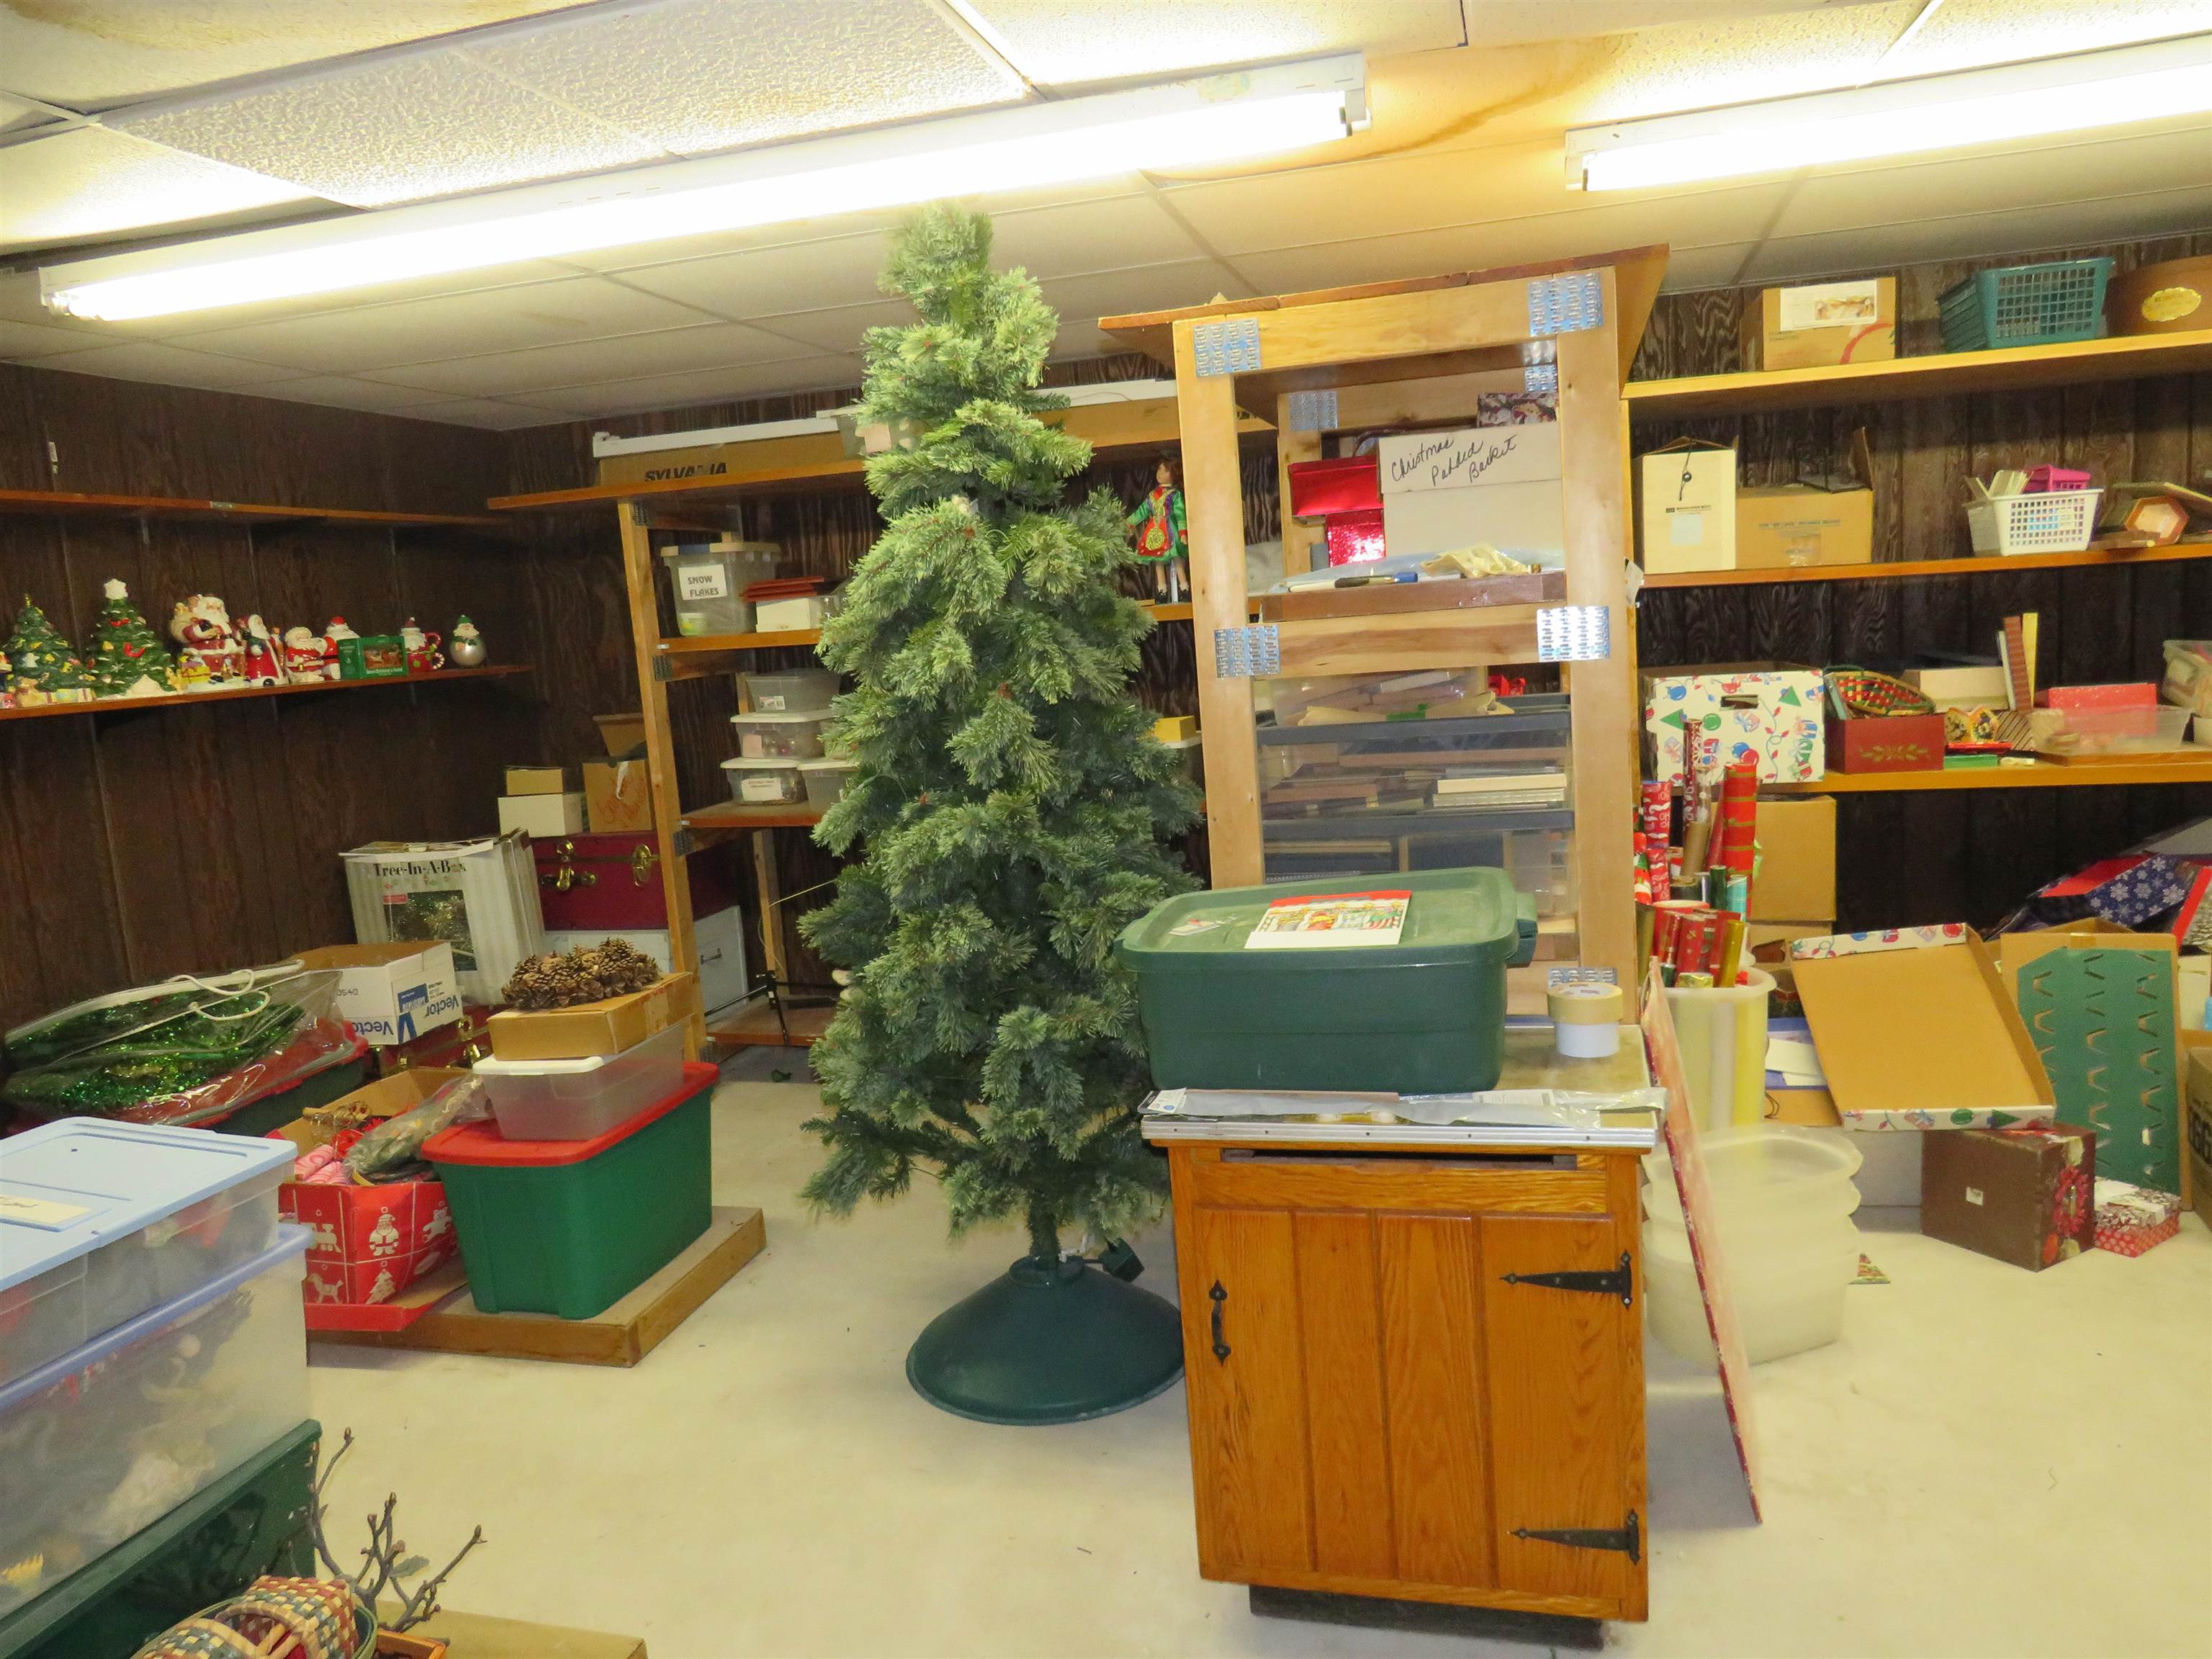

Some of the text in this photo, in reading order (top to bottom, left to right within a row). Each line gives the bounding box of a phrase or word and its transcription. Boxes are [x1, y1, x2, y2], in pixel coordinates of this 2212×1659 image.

[1391, 437, 1455, 482] Christmas
[1431, 441, 1484, 486] Padded
[1469, 434, 1518, 483] Basket
[644, 462, 727, 482] SYLVAIA
[687, 575, 713, 584] SNOW
[689, 588, 719, 597] FLAKES
[426, 995, 459, 1017] Vector
[352, 1021, 394, 1035] Vecto
